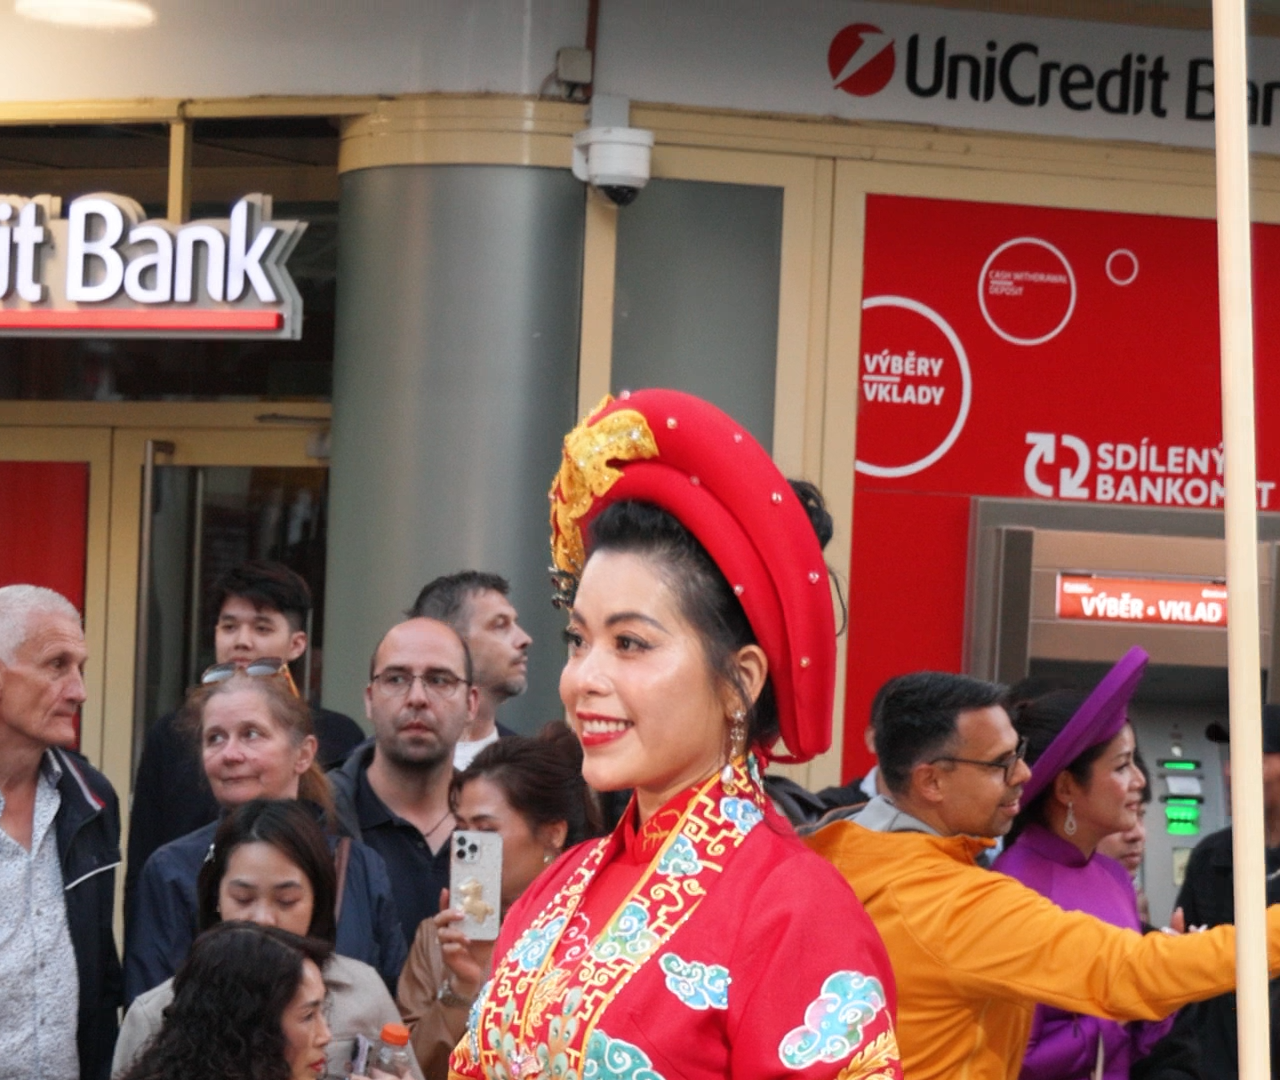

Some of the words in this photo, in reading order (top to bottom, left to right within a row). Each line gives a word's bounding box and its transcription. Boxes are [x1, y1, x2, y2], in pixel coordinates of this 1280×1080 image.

[906, 34, 1168, 118] UniCredit
[66, 197, 279, 303] Bank
[864, 348, 944, 377] VÝBĚRY
[863, 382, 945, 406] VKLADY
[1096, 474, 1276, 508] BANKOT
[1080, 591, 1144, 619] VÝBĚR
[1158, 600, 1222, 622] VKLAD
